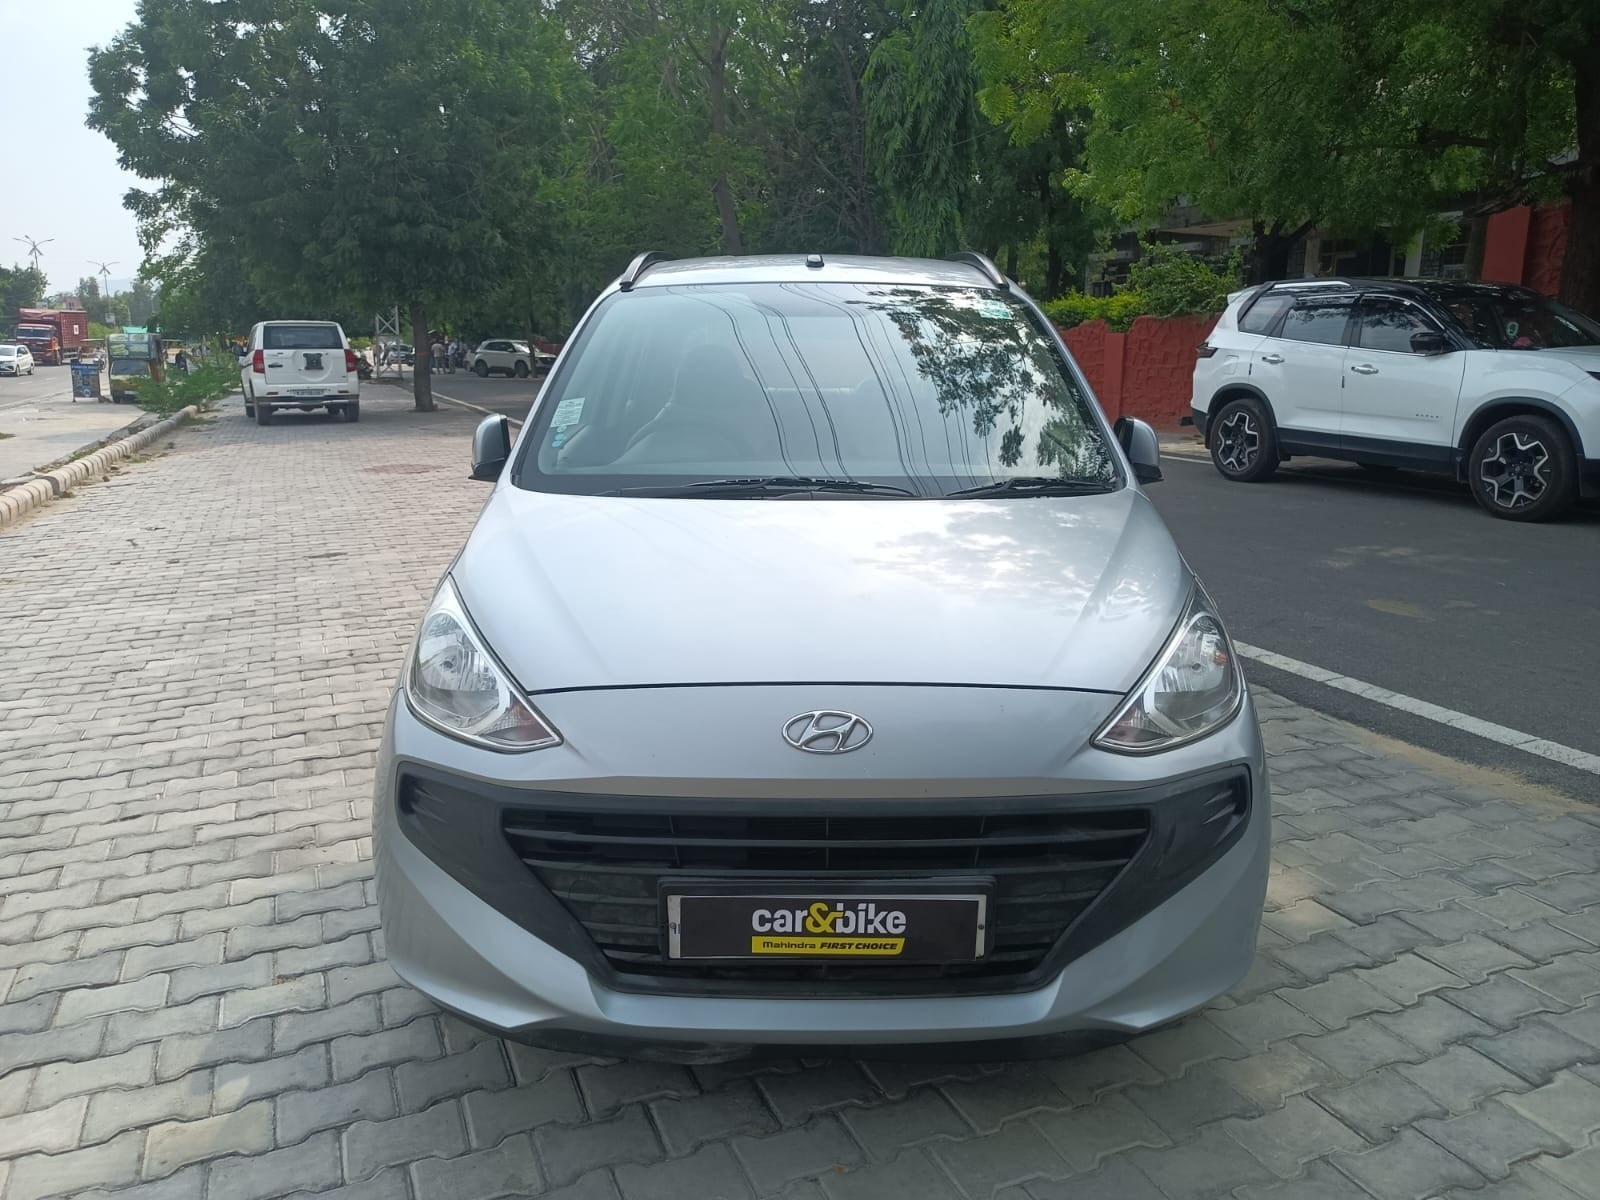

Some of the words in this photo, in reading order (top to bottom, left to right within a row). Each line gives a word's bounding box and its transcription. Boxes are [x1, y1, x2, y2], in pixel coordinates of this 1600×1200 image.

[752, 902, 906, 934] car&bike
[763, 941, 816, 949] Mahindra
[820, 942, 855, 950] FIRST
[855, 942, 897, 950] CHOICE
